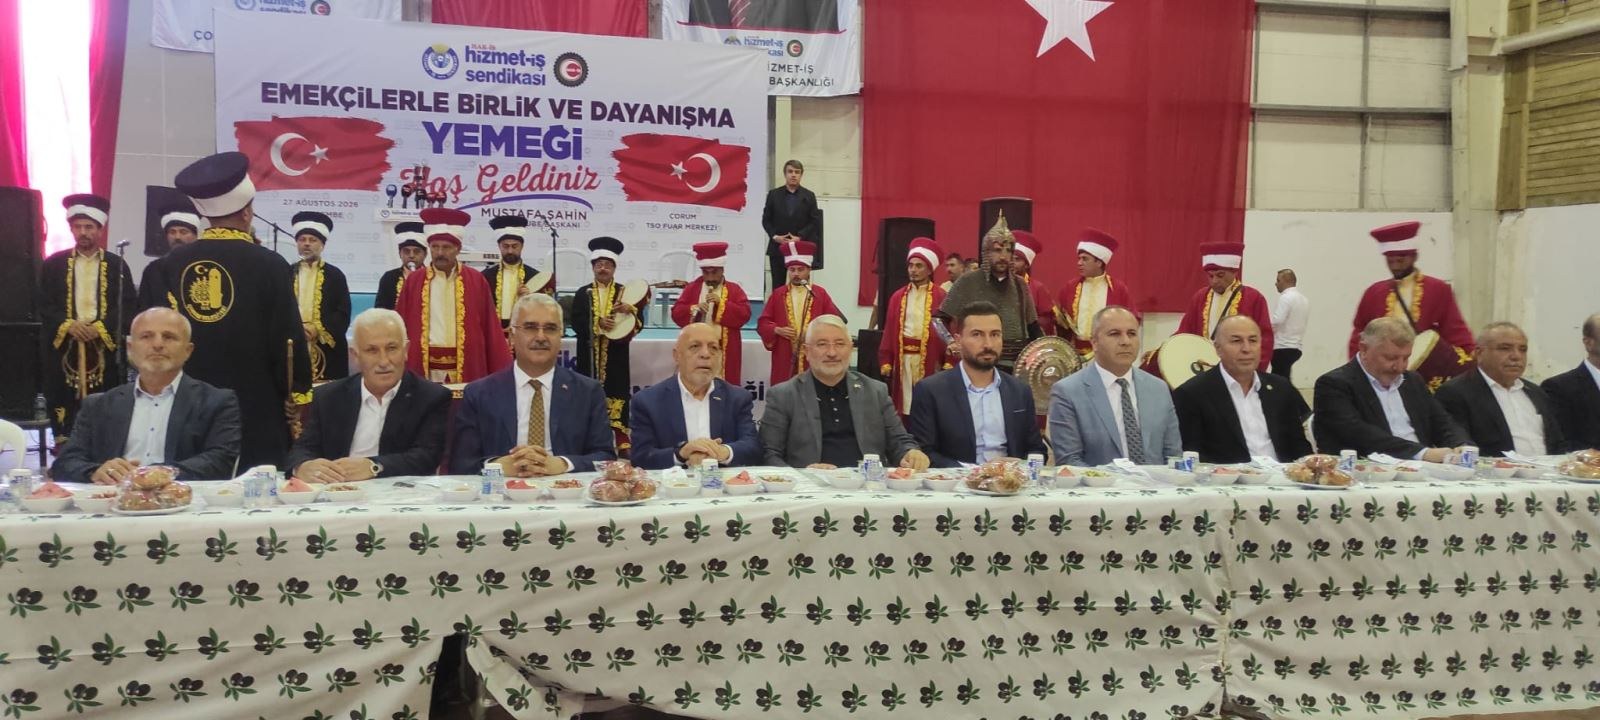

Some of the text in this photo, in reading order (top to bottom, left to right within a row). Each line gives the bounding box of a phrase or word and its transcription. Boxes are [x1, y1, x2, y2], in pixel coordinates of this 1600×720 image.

[465, 45, 546, 71] hizmet-iş
[465, 68, 546, 86] sendikası
[769, 77, 834, 87] BAŞKANLIĞI
[261, 82, 736, 130] EMEKÇİLERLE BİRLİK VE DAYANIŞMA
[422, 121, 583, 160] YEMEĞİ
[400, 163, 602, 206] Hoş Geldiniz
[296, 198, 335, 207] AĞUSTOS
[481, 207, 541, 219] MUSTAFA
